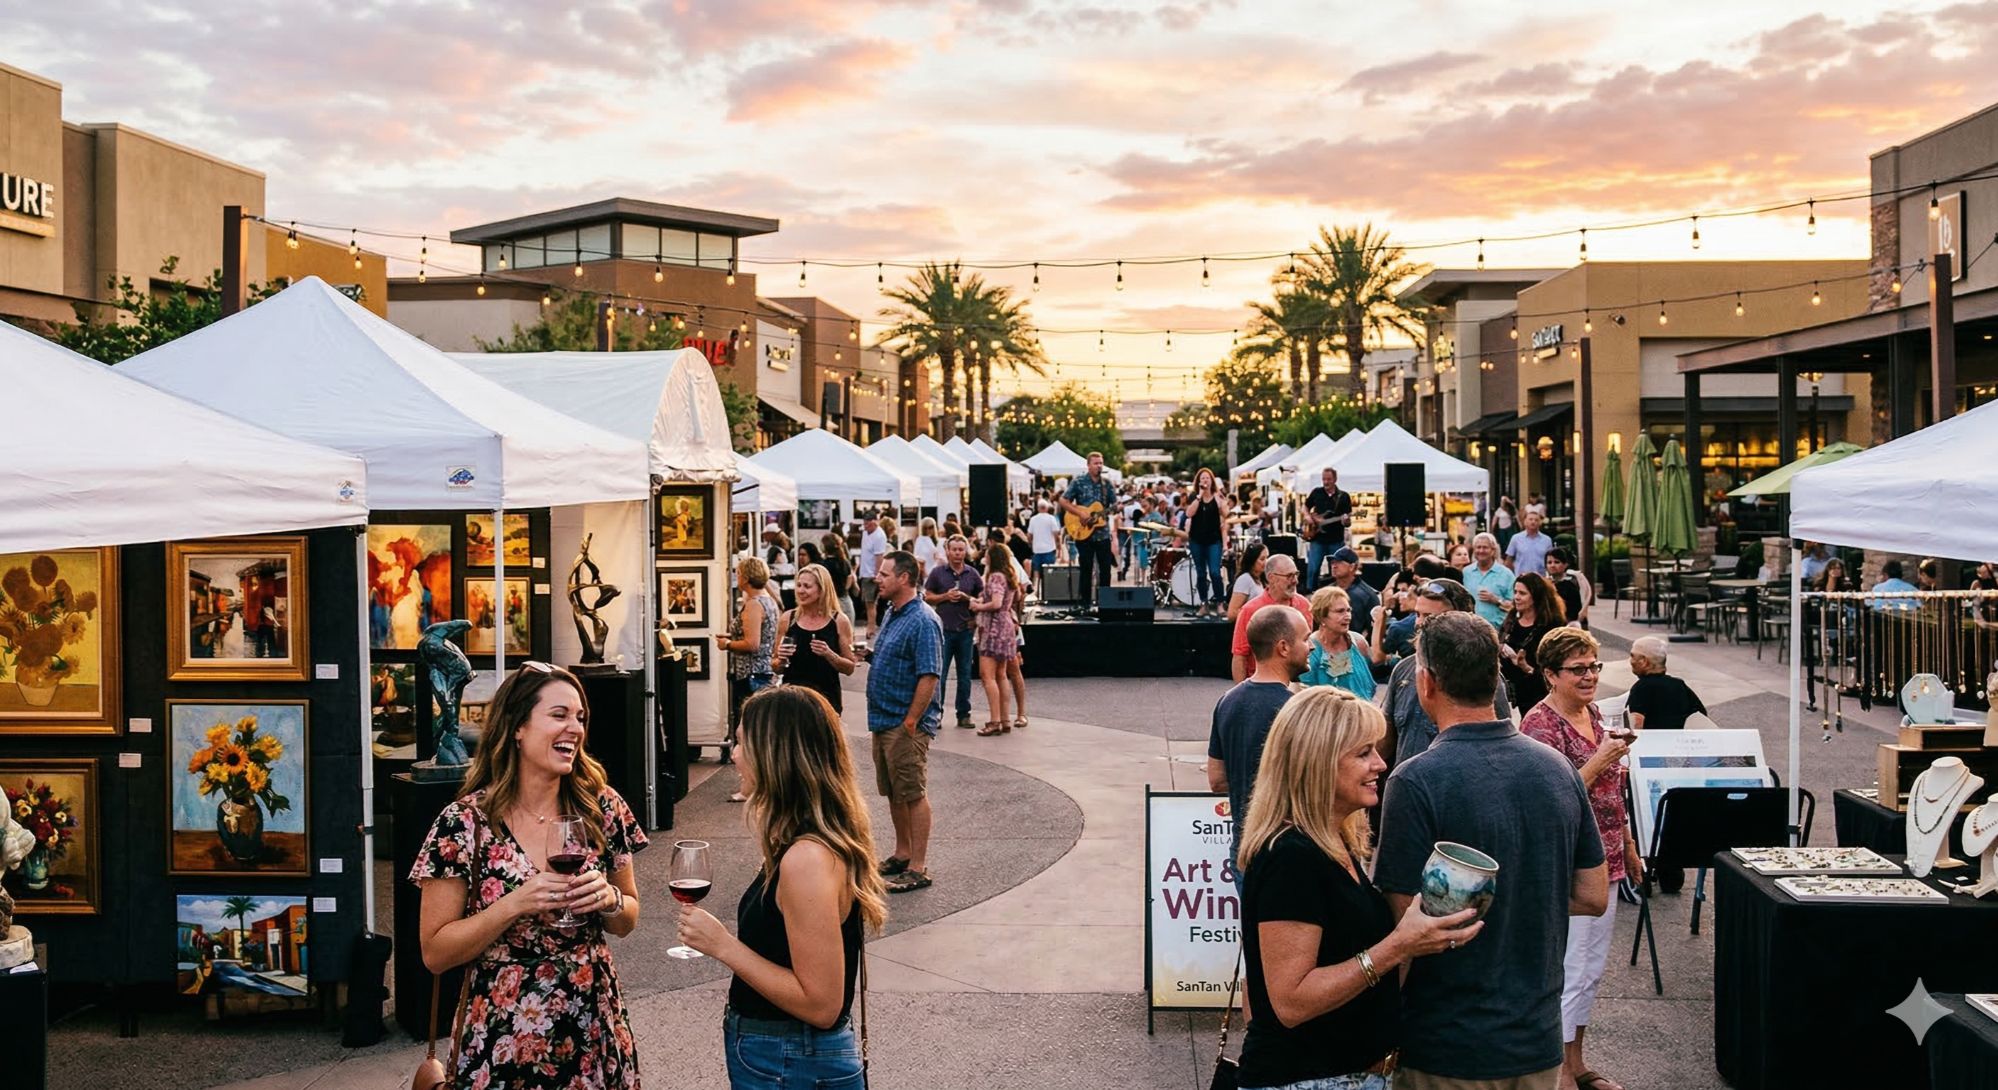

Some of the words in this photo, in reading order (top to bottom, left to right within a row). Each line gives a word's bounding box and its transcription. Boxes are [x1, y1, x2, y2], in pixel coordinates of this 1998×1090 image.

[3, 172, 54, 218] URE
[1162, 857, 1212, 883] Art
[1220, 858, 1235, 883] &
[1162, 887, 1239, 919] Win
[1176, 981, 1221, 992] SanTan
